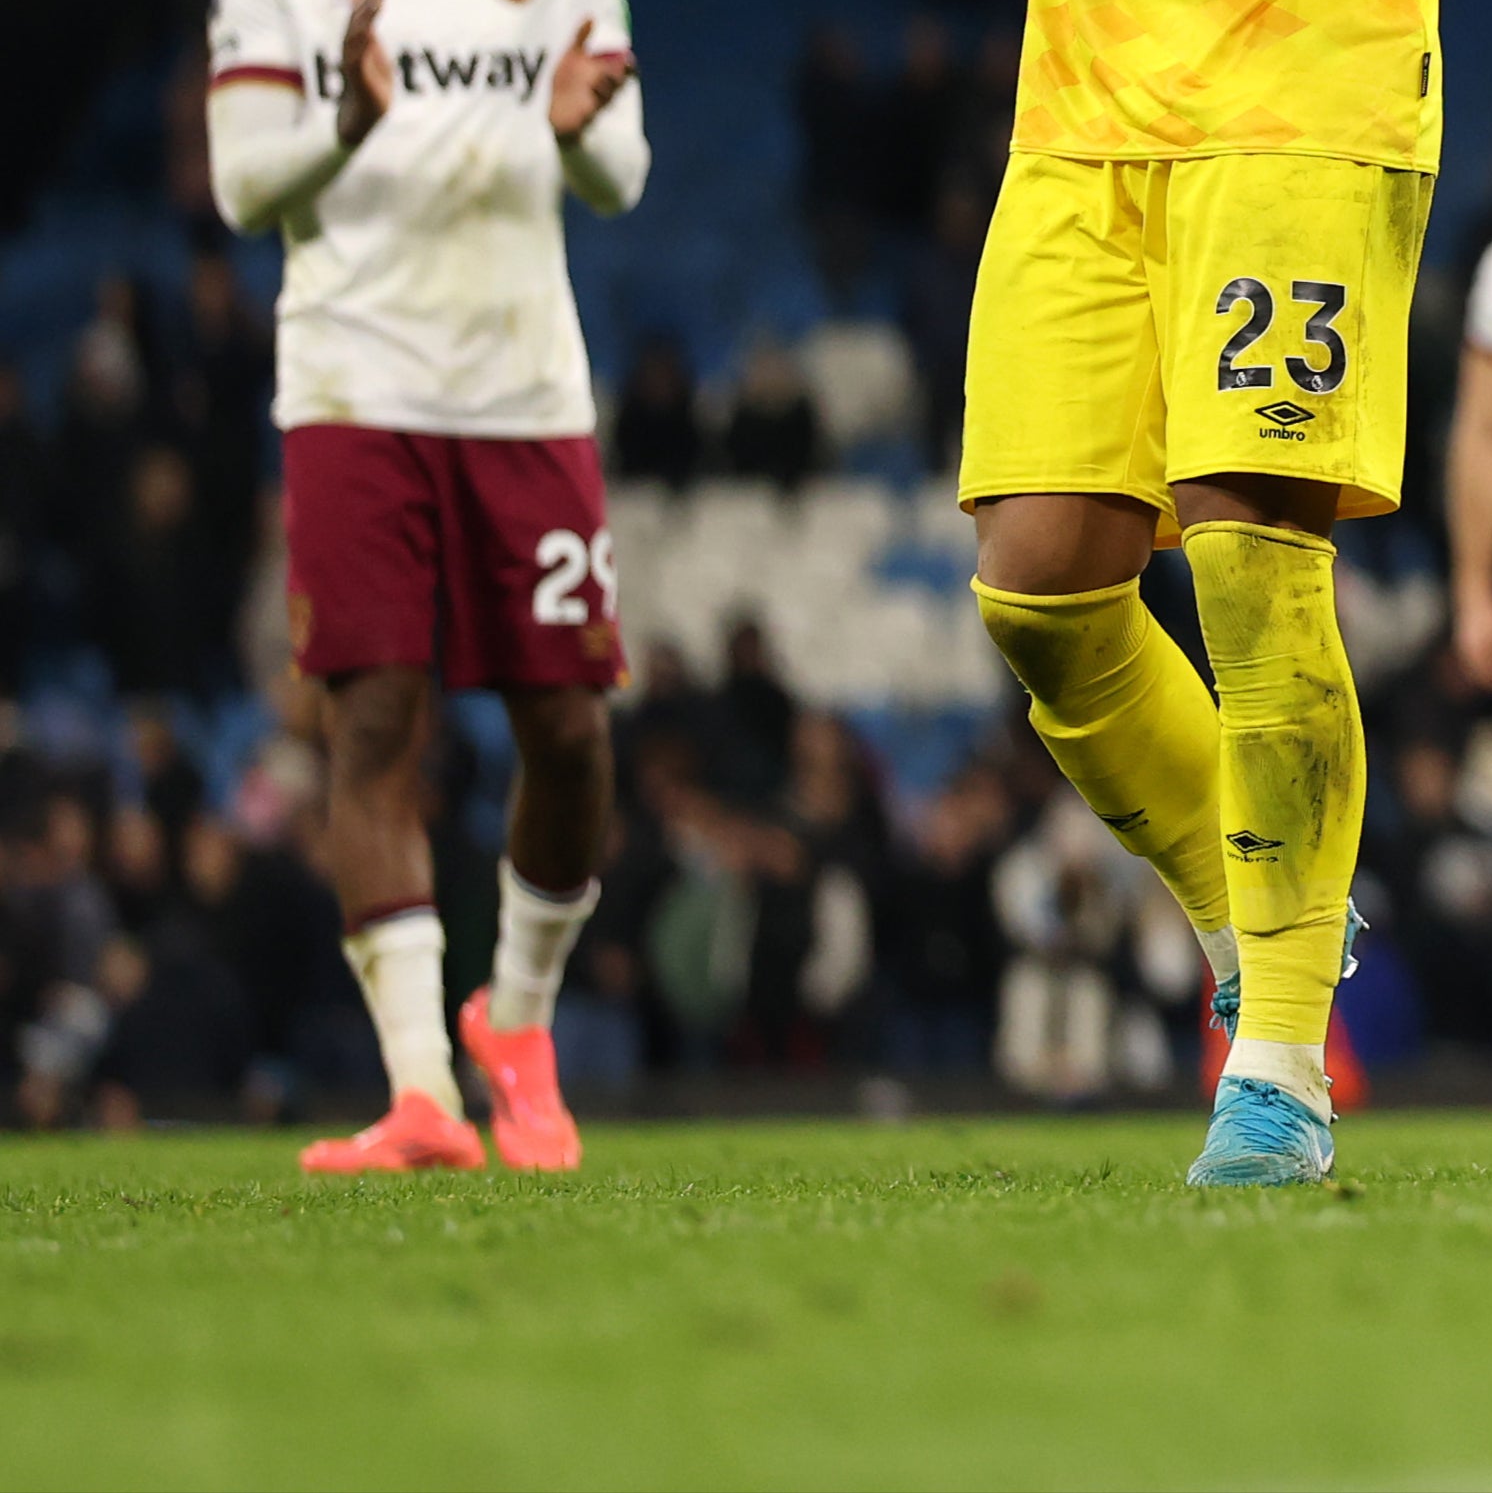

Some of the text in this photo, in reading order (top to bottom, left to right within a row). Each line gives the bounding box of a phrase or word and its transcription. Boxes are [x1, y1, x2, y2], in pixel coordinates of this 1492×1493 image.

[316, 47, 546, 103] btway
[1215, 277, 1348, 395] 23
[1259, 427, 1306, 441] umbro
